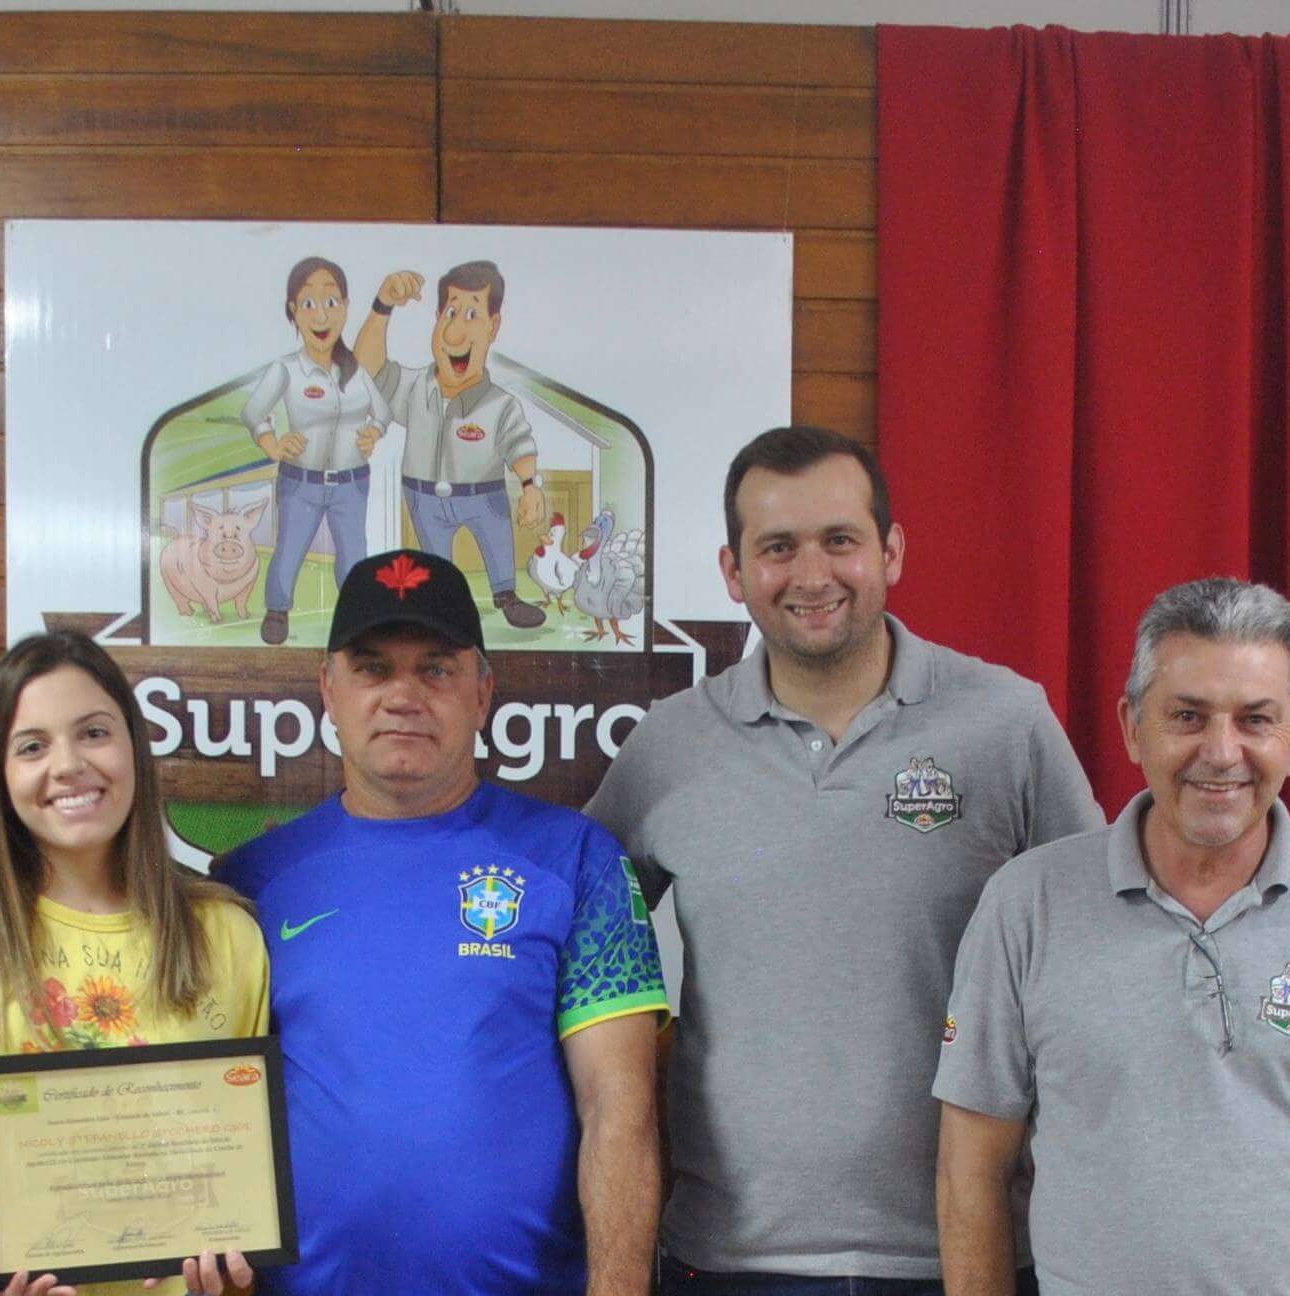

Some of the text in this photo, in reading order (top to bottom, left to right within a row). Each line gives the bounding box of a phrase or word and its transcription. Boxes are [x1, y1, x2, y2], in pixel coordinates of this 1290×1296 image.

[893, 801, 954, 813] SuperAgro
[82, 944, 122, 973] SUA
[458, 943, 516, 959] BRASIL
